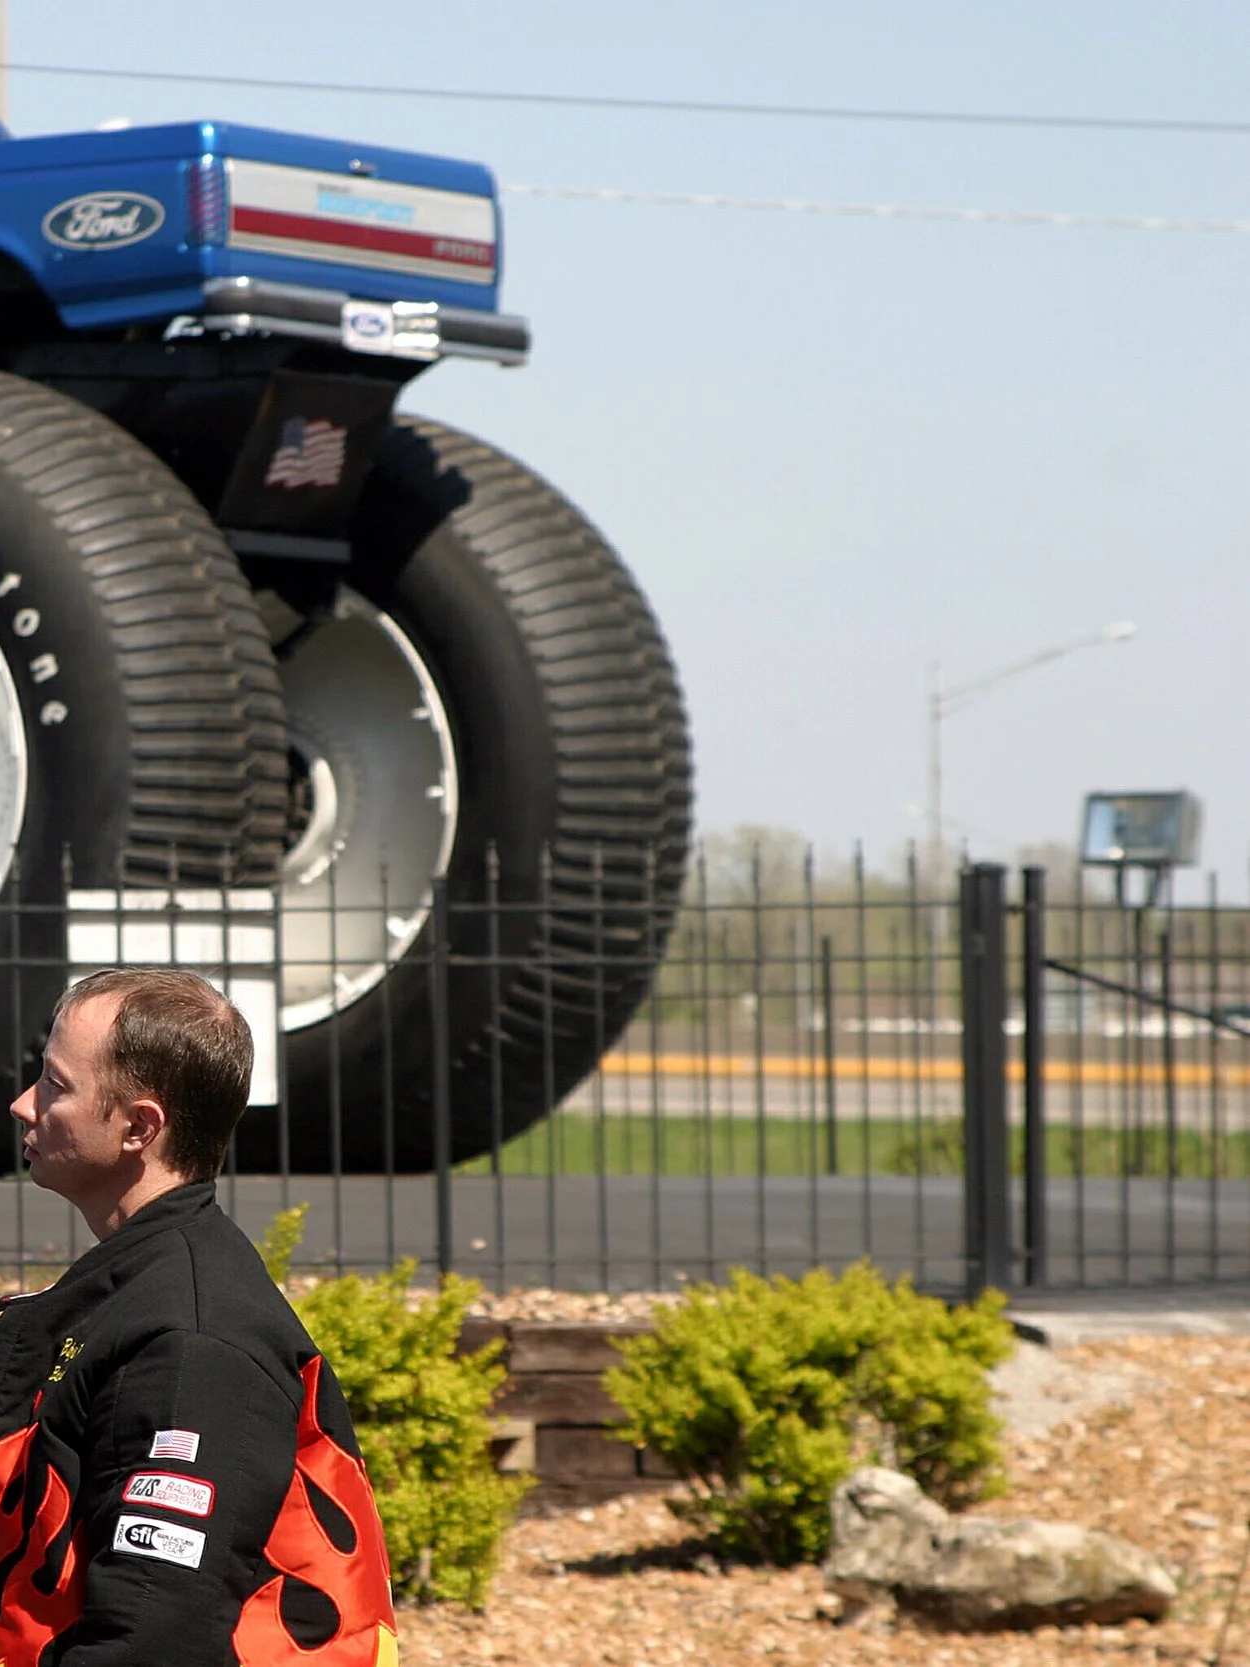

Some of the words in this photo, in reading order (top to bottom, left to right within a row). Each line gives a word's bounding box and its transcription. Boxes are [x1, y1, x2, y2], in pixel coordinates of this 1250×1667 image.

[63, 200, 142, 240] Ford
[130, 1478, 161, 1498] RJS
[165, 1481, 207, 1501] RACING
[130, 1526, 153, 1545] sfi
